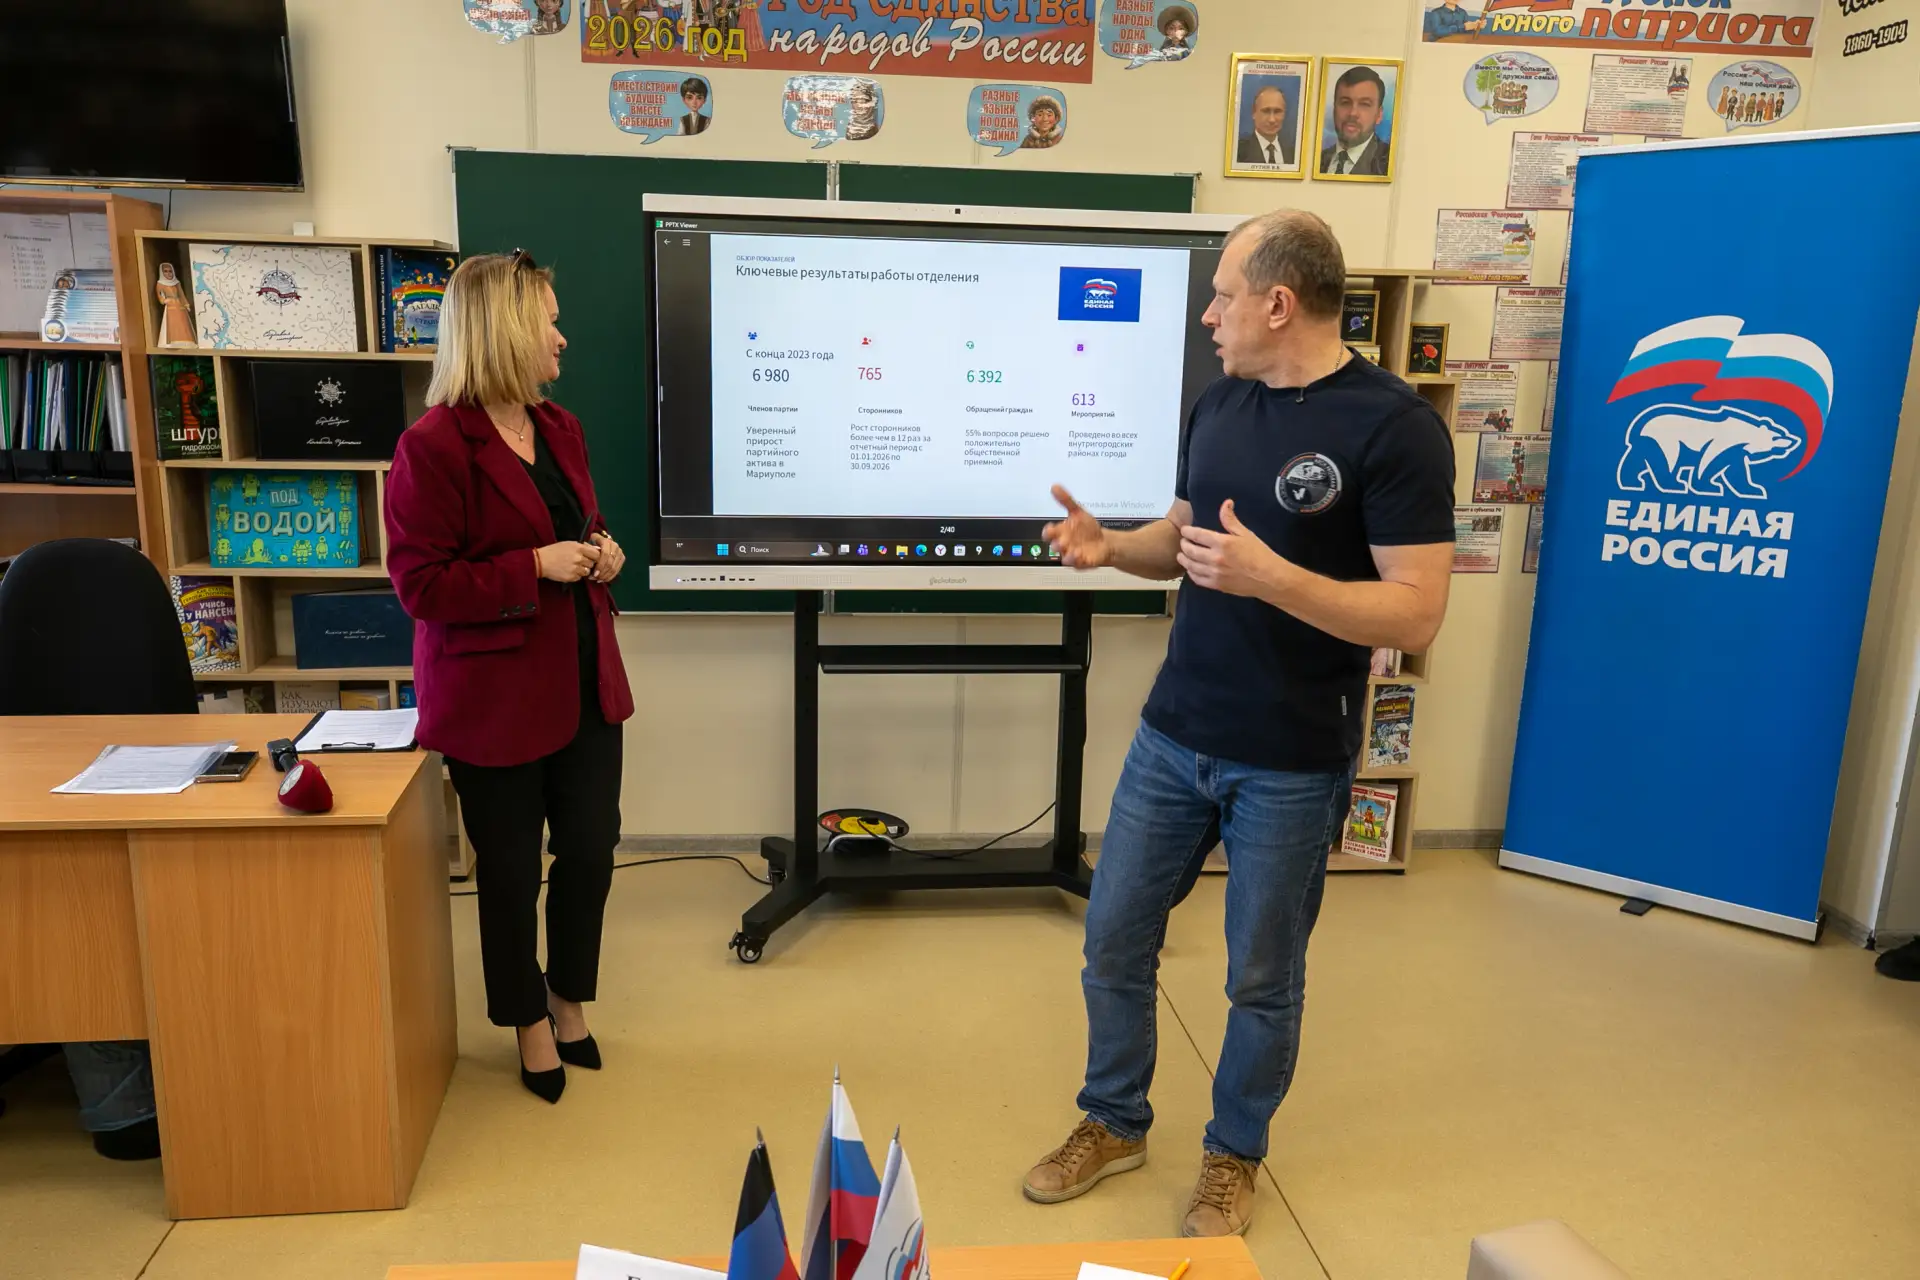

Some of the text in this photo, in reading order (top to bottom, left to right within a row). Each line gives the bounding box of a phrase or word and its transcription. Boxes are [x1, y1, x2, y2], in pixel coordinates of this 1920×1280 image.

[1116, 0, 1154, 12] РАЗНЫЕ
[1491, 14, 1575, 34] юного
[1579, 8, 1815, 50] патриота
[588, 15, 748, 62] 2026 год
[1120, 28, 1146, 40] ОДНА
[1843, 19, 1908, 57] 1860-1904
[769, 16, 1087, 70] народов России
[613, 81, 678, 92] ВМЕСТЕ СТРОИМ
[982, 90, 1019, 102] РАЗНЫЕ
[630, 106, 662, 115] ВМЕСТЕ
[980, 116, 1019, 128] НО ОДНА
[736, 265, 979, 283] Ключевые результаты работы отделения
[746, 349, 834, 361] С конца 2023 года
[752, 368, 790, 382] 6 980
[858, 367, 882, 381] 765
[966, 370, 1002, 383] 6 392
[1072, 393, 1095, 406] 613
[966, 405, 1004, 414] Обращений
[1071, 410, 1115, 418] Мероприятий
[746, 426, 796, 435] Уверенный
[850, 424, 921, 433] Рост сторонников
[171, 428, 219, 444] штур
[850, 434, 873, 442] более
[897, 434, 906, 442] 12
[1069, 431, 1110, 439] Проведено
[746, 438, 783, 446] прирост
[1068, 440, 1133, 448] внутригородских
[746, 448, 799, 457] партийного
[889, 444, 918, 452] период
[850, 453, 890, 461] 01.01.2026
[964, 449, 1020, 457] общественной
[1068, 450, 1127, 458] районах города
[746, 459, 777, 467] актива
[850, 462, 890, 471] 30.09.2026
[964, 458, 1002, 466] приемной
[746, 470, 796, 479] Мариуполе
[271, 488, 298, 503] ПОД
[1120, 501, 1155, 509] Windows
[233, 508, 337, 537] ВОДОЙ
[1605, 499, 1794, 540] ЕДИНАЯ
[940, 526, 955, 534] 2/40
[750, 546, 769, 554] Поиск
[1601, 533, 1789, 579] РОССИЯ
[200, 601, 225, 609] УЧИСЬ
[186, 612, 192, 620] У
[281, 691, 302, 700] КАК
[281, 700, 334, 709] ИЗУЧАЮТ
